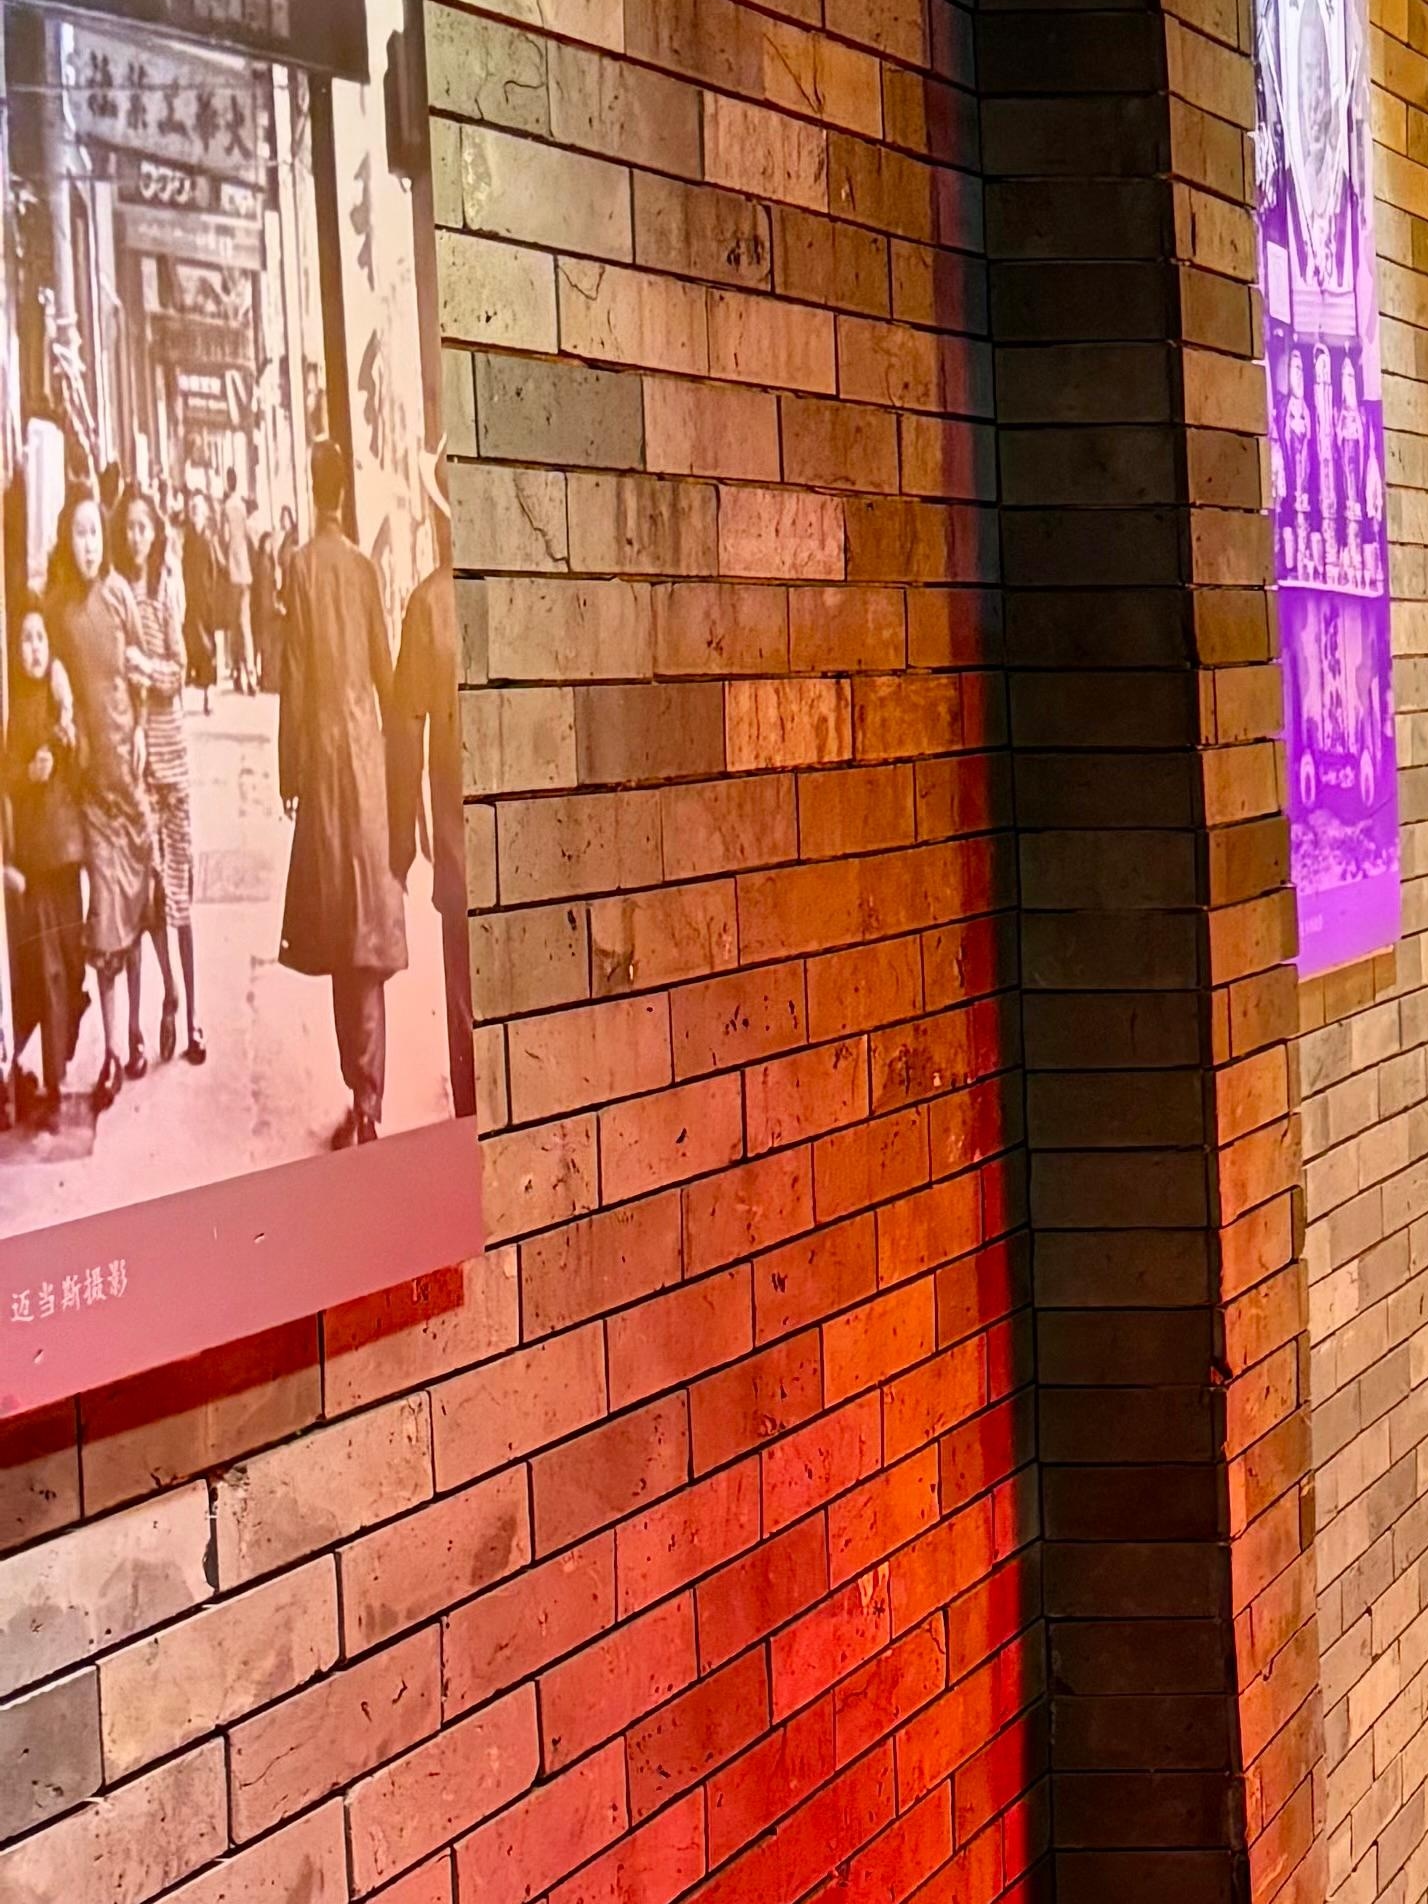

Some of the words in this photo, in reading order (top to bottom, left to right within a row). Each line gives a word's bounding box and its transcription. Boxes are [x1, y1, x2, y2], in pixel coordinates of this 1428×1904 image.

[11, 1259, 128, 1322] 迈当斯摄影
